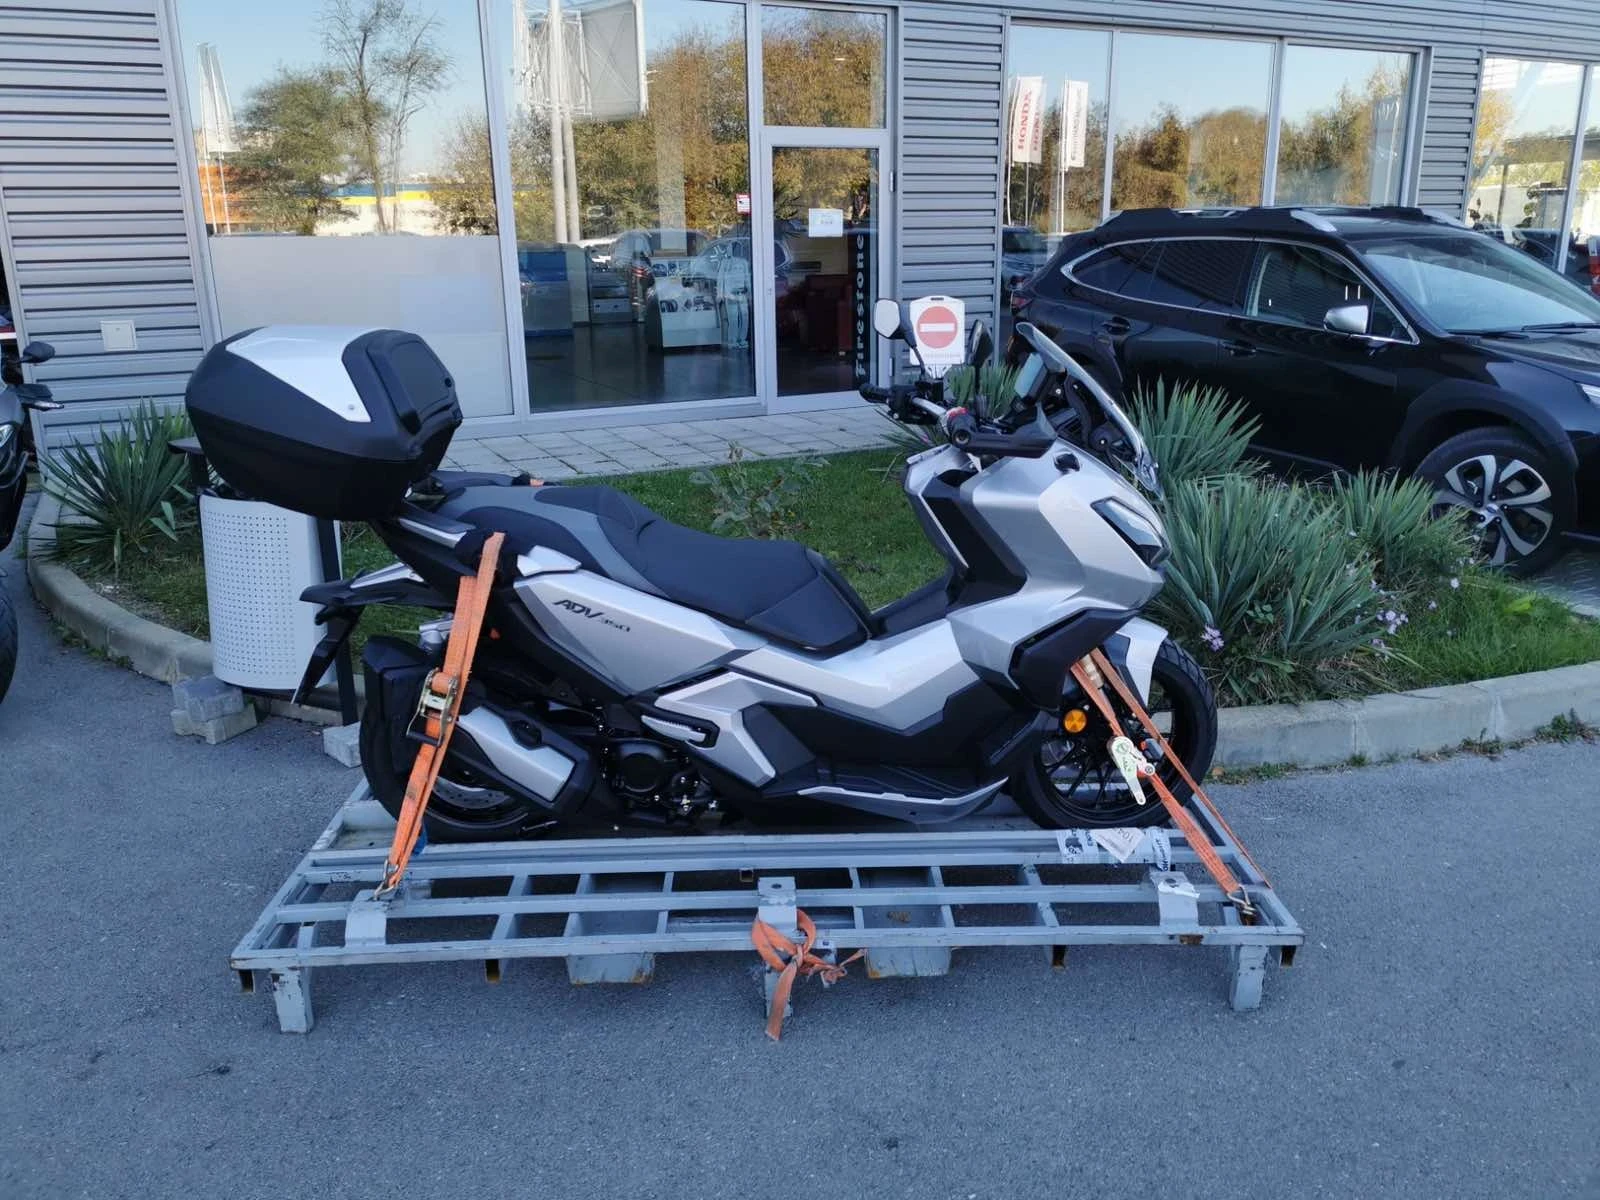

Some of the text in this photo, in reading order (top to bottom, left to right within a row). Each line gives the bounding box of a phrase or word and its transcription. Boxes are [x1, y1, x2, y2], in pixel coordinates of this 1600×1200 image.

[1017, 88, 1032, 150] HONDA
[855, 234, 866, 377] Firestone
[553, 599, 605, 619] ADV
